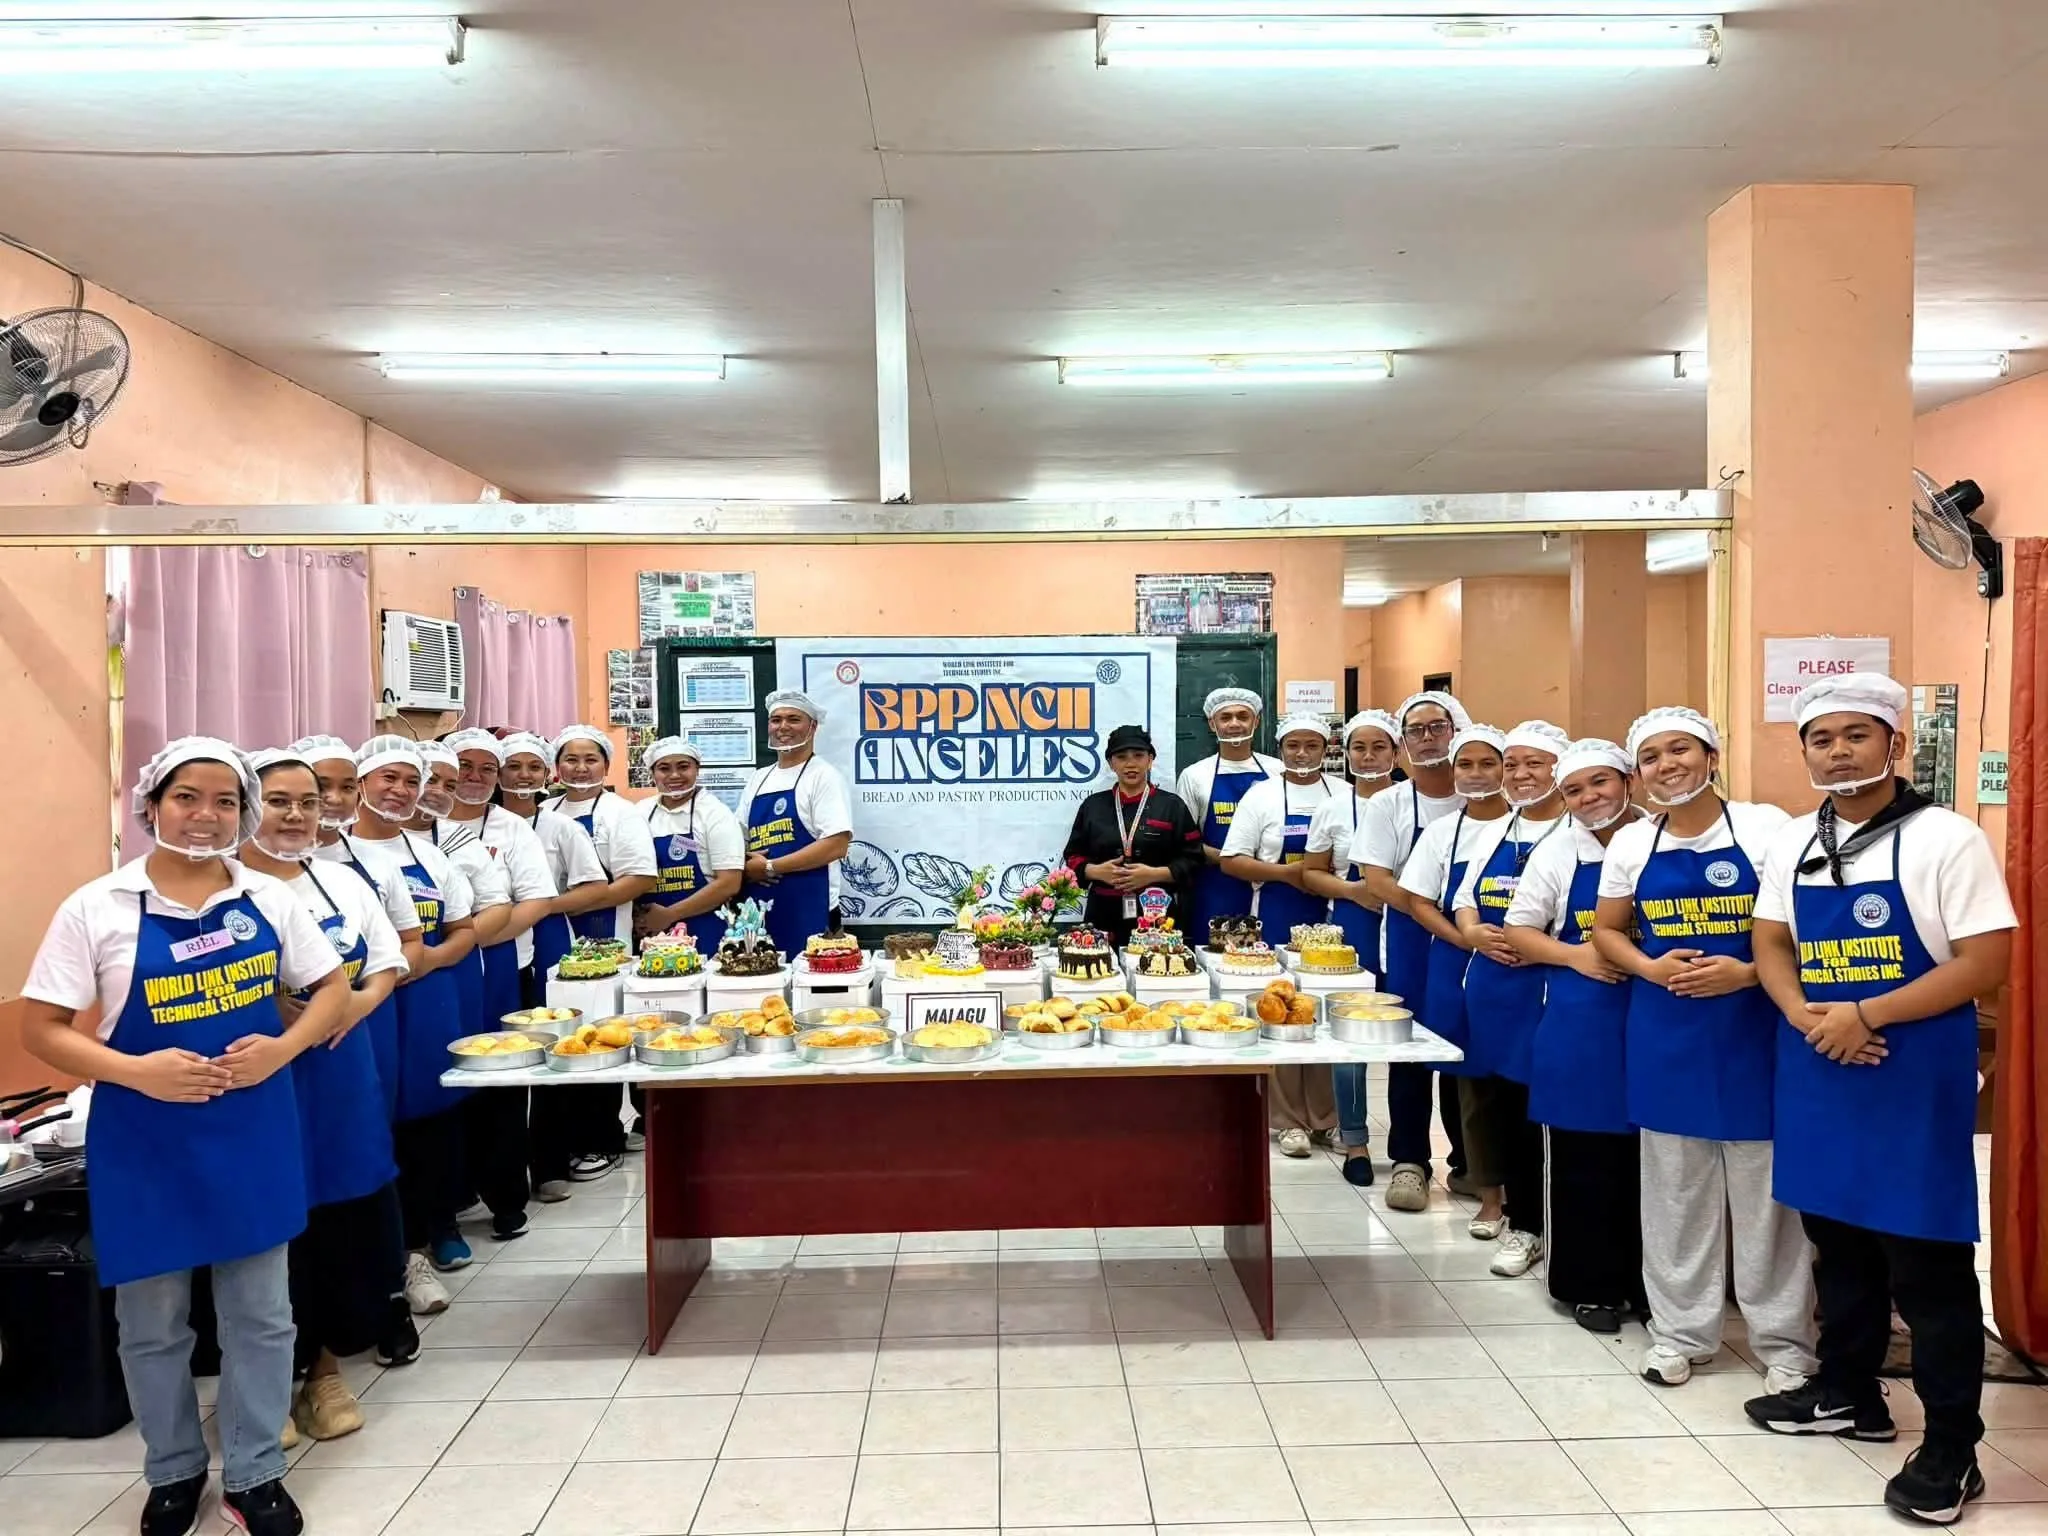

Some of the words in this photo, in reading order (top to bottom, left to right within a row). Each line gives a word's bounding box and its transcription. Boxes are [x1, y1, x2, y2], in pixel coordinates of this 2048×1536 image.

[1798, 660, 1856, 674] PLEASE
[1767, 683, 1802, 695] Clean
[862, 685, 978, 733] BPP
[857, 735, 1099, 783] ANGELES
[862, 791, 904, 803] BREAD
[908, 791, 934, 802] AND
[938, 790, 985, 803] PASTRY
[989, 789, 1066, 803] PRODUCTION
[1641, 899, 1675, 921] WORLD
[1675, 897, 1700, 915] LINK
[1695, 920, 1738, 935] STUDIES
[185, 936, 220, 953] RIEL
[1814, 940, 1841, 960] LINK
[1841, 935, 1904, 961] INSTITUTE
[1823, 957, 1850, 968] FOR
[1835, 966, 1880, 983] STUDIES
[1881, 963, 1905, 980] INC.
[144, 974, 195, 1007] WORLD
[196, 966, 225, 992] LINK
[205, 983, 237, 999] FOR
[151, 998, 221, 1025] TECHNICAL
[220, 983, 263, 1012] STUDIES
